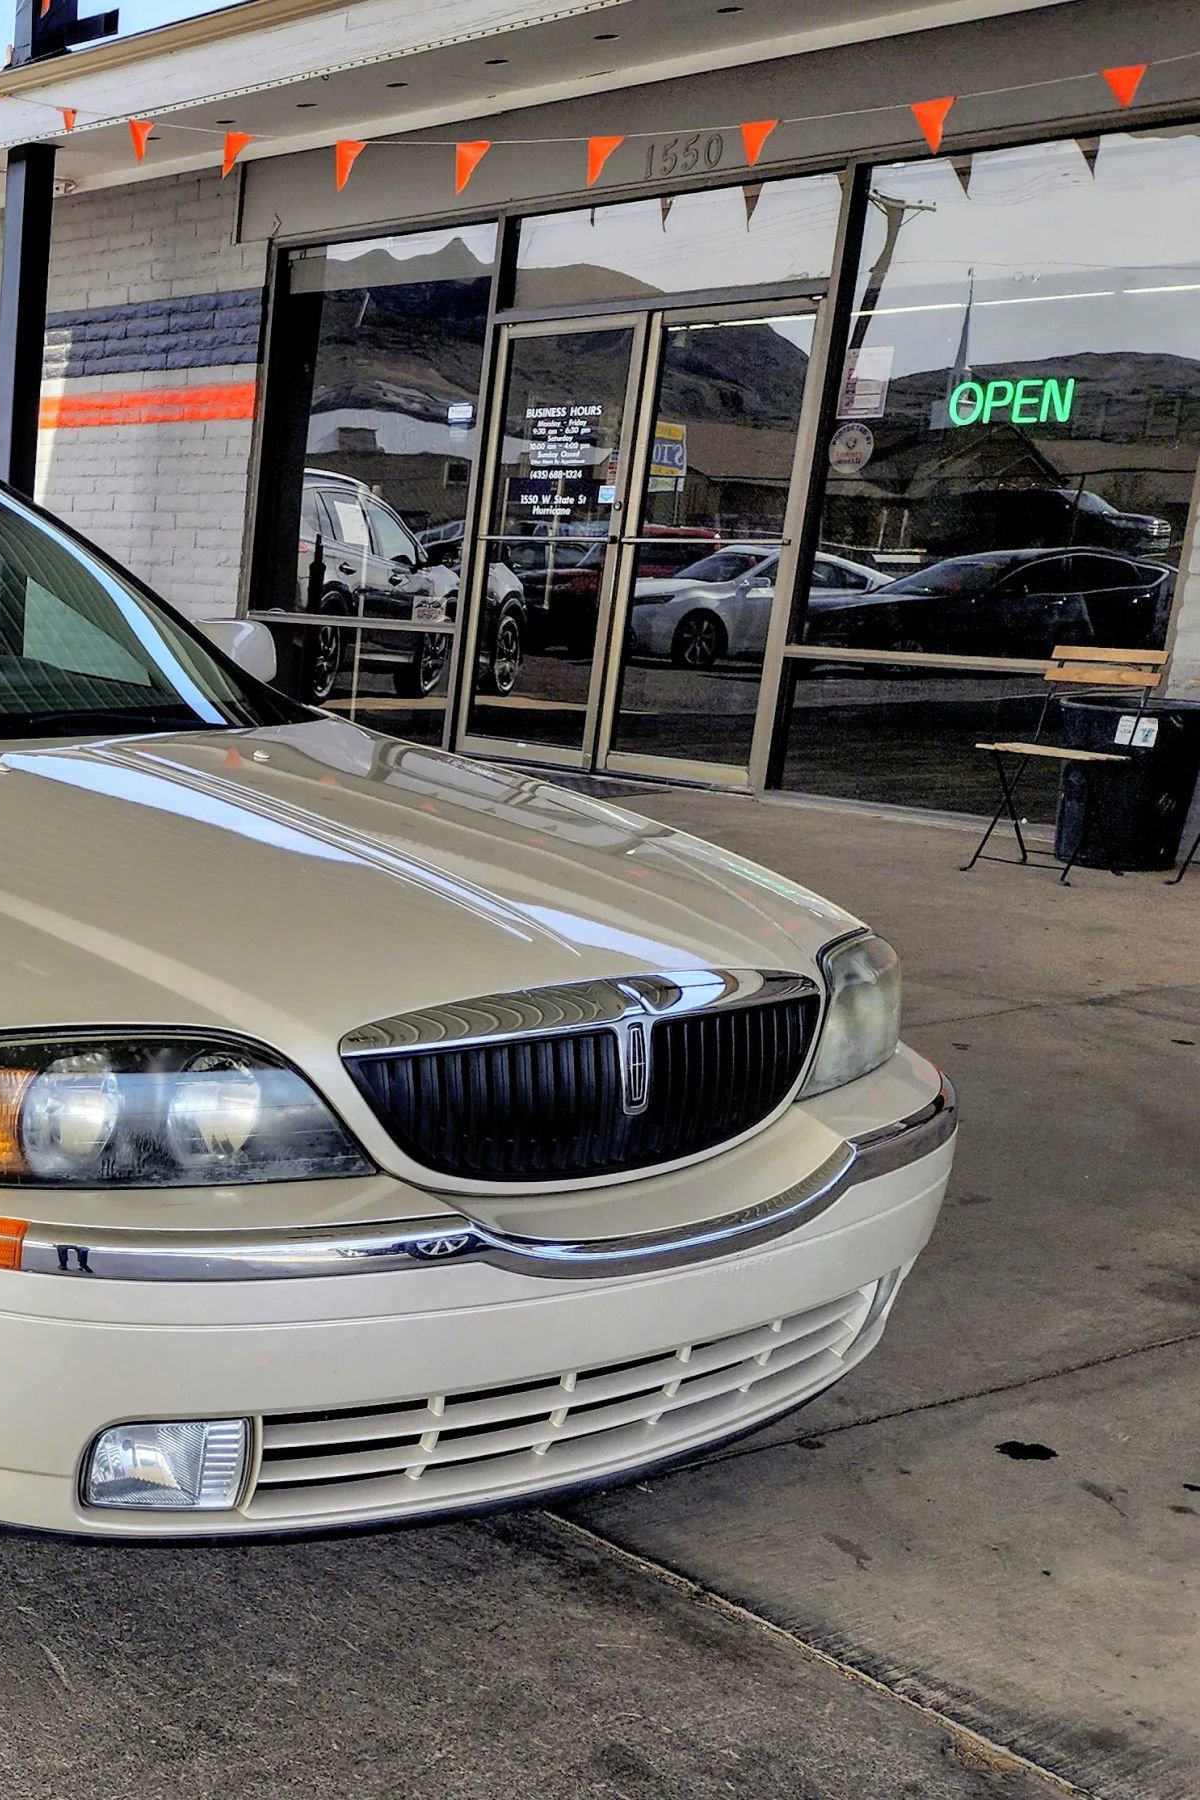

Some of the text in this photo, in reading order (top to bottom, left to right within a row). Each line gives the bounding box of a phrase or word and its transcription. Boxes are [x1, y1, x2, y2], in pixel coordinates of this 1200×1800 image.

[644, 133, 724, 180] 1550
[949, 378, 1075, 426] OPEN
[526, 405, 602, 418] BUSINESS HOURS
[568, 418, 587, 427] Friday
[529, 469, 582, 480] (435) 688-1324
[520, 494, 587, 505] 1550 W State St
[532, 505, 571, 516] Hurricane
